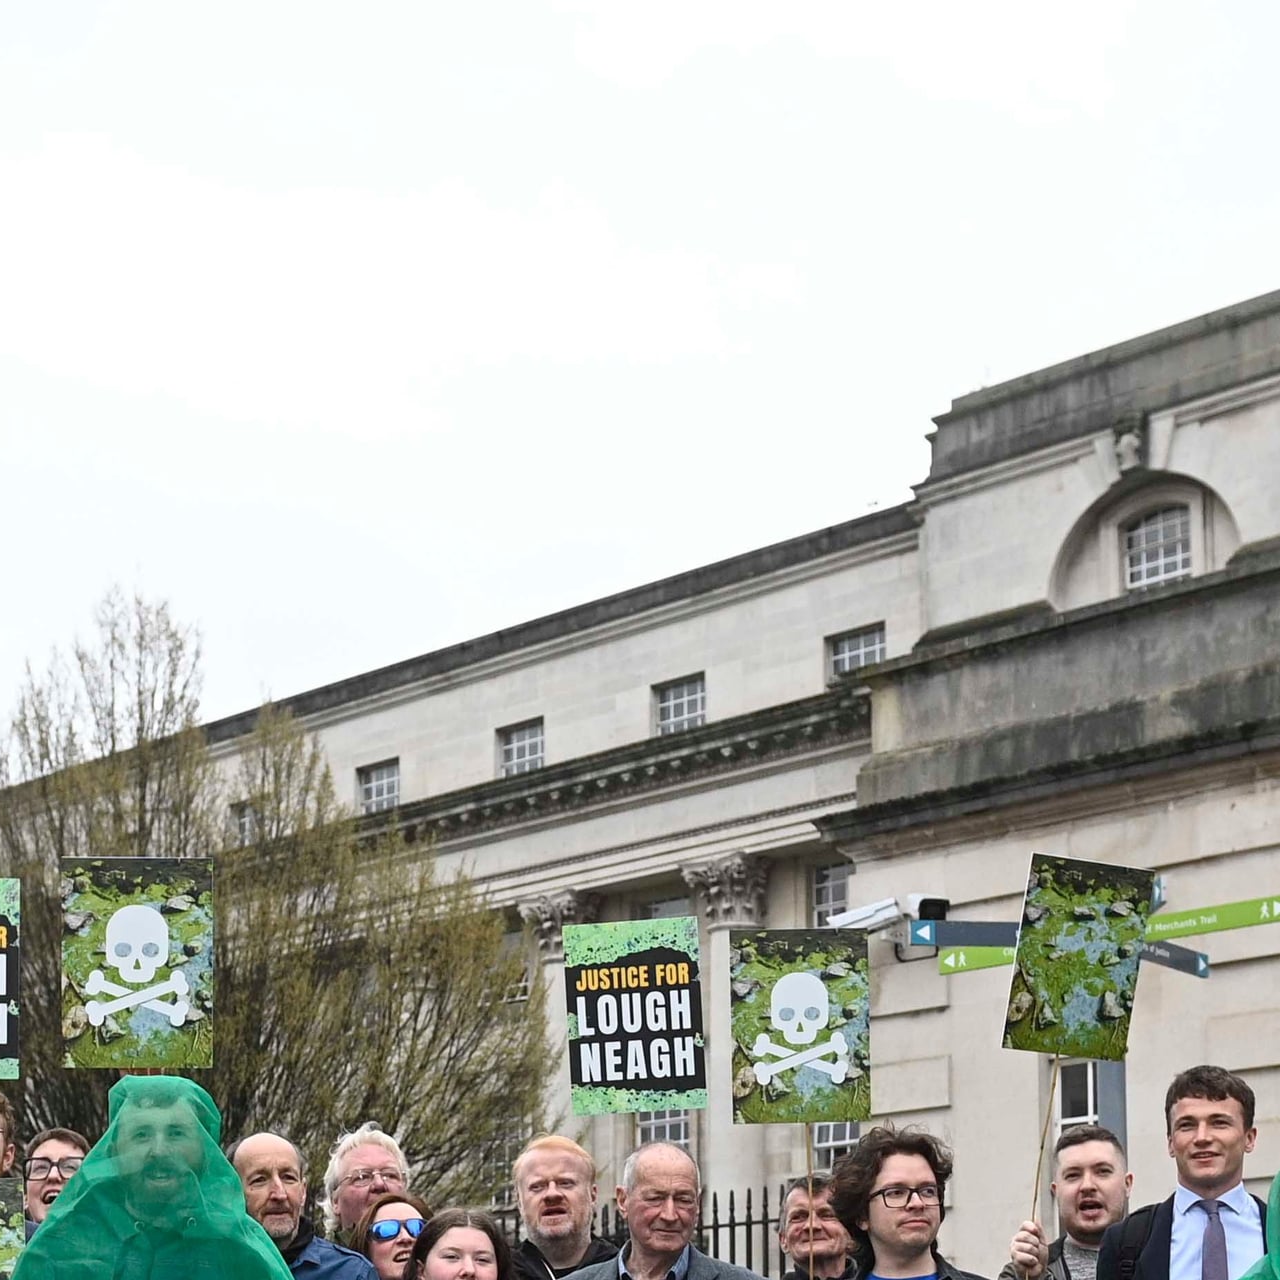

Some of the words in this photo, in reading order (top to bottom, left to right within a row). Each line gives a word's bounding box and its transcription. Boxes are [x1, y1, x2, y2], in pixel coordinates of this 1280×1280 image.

[1155, 918, 1197, 931] Merchants
[1200, 914, 1217, 924] Trail
[576, 965, 649, 992] JUSTICE
[655, 962, 690, 986] FOR
[576, 989, 692, 1037] LOUGH
[580, 1036, 696, 1083] NEAGH
